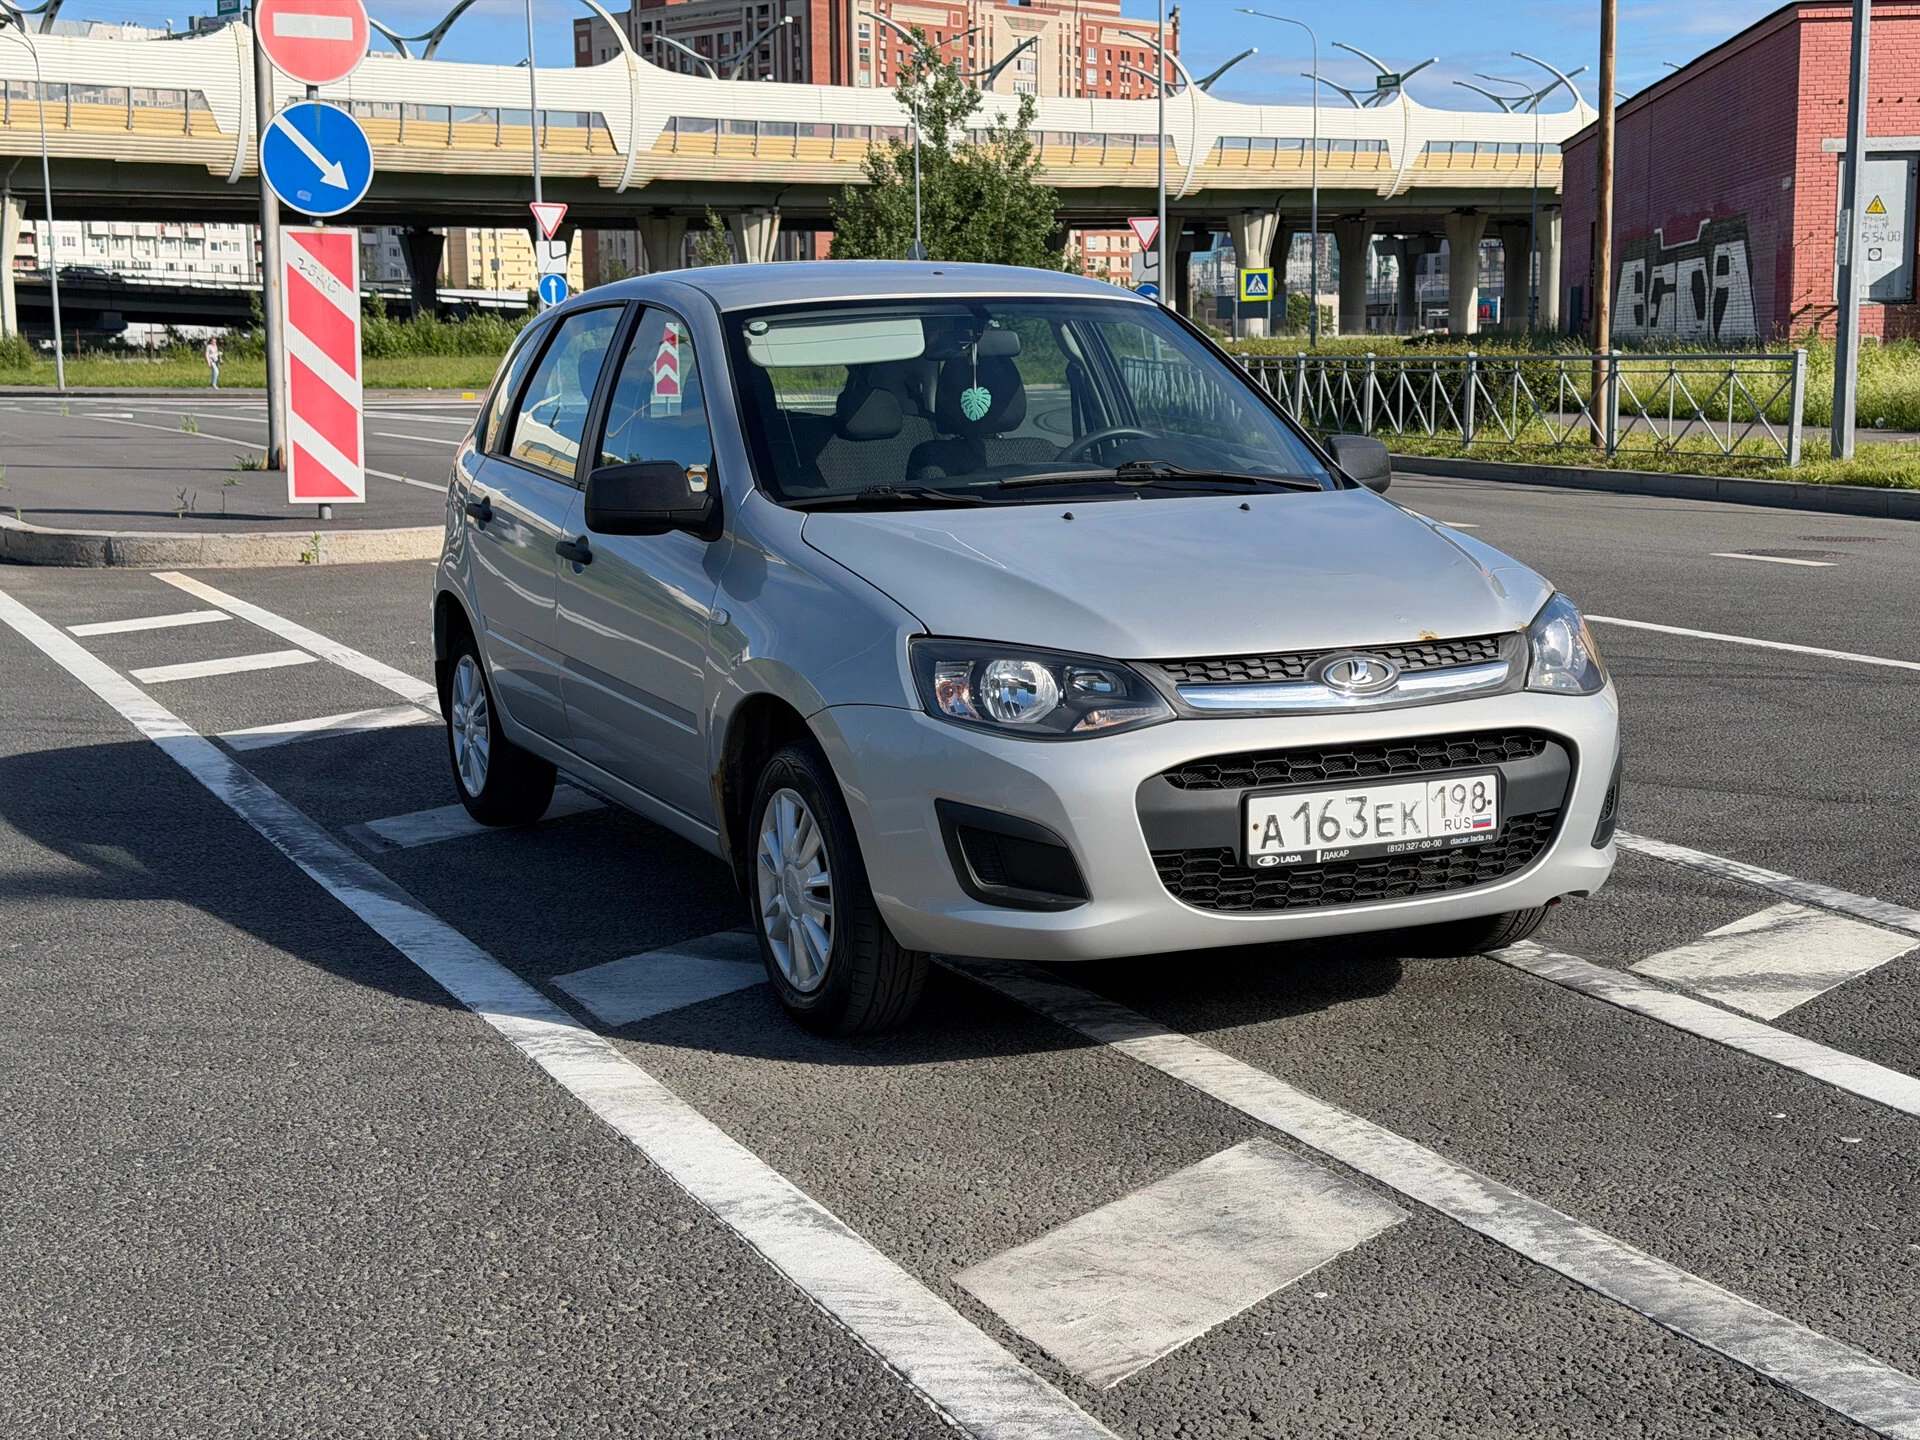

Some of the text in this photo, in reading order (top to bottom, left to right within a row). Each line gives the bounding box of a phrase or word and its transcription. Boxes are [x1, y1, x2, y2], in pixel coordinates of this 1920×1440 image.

[1431, 781, 1487, 819] 198
[1444, 816, 1471, 831] RUS
[1387, 839, 1443, 854] (812) 327-00-00
[1450, 834, 1493, 846] dacar.lada.ru
[1280, 854, 1302, 864] LADA
[1322, 849, 1350, 861] ДАКАР
